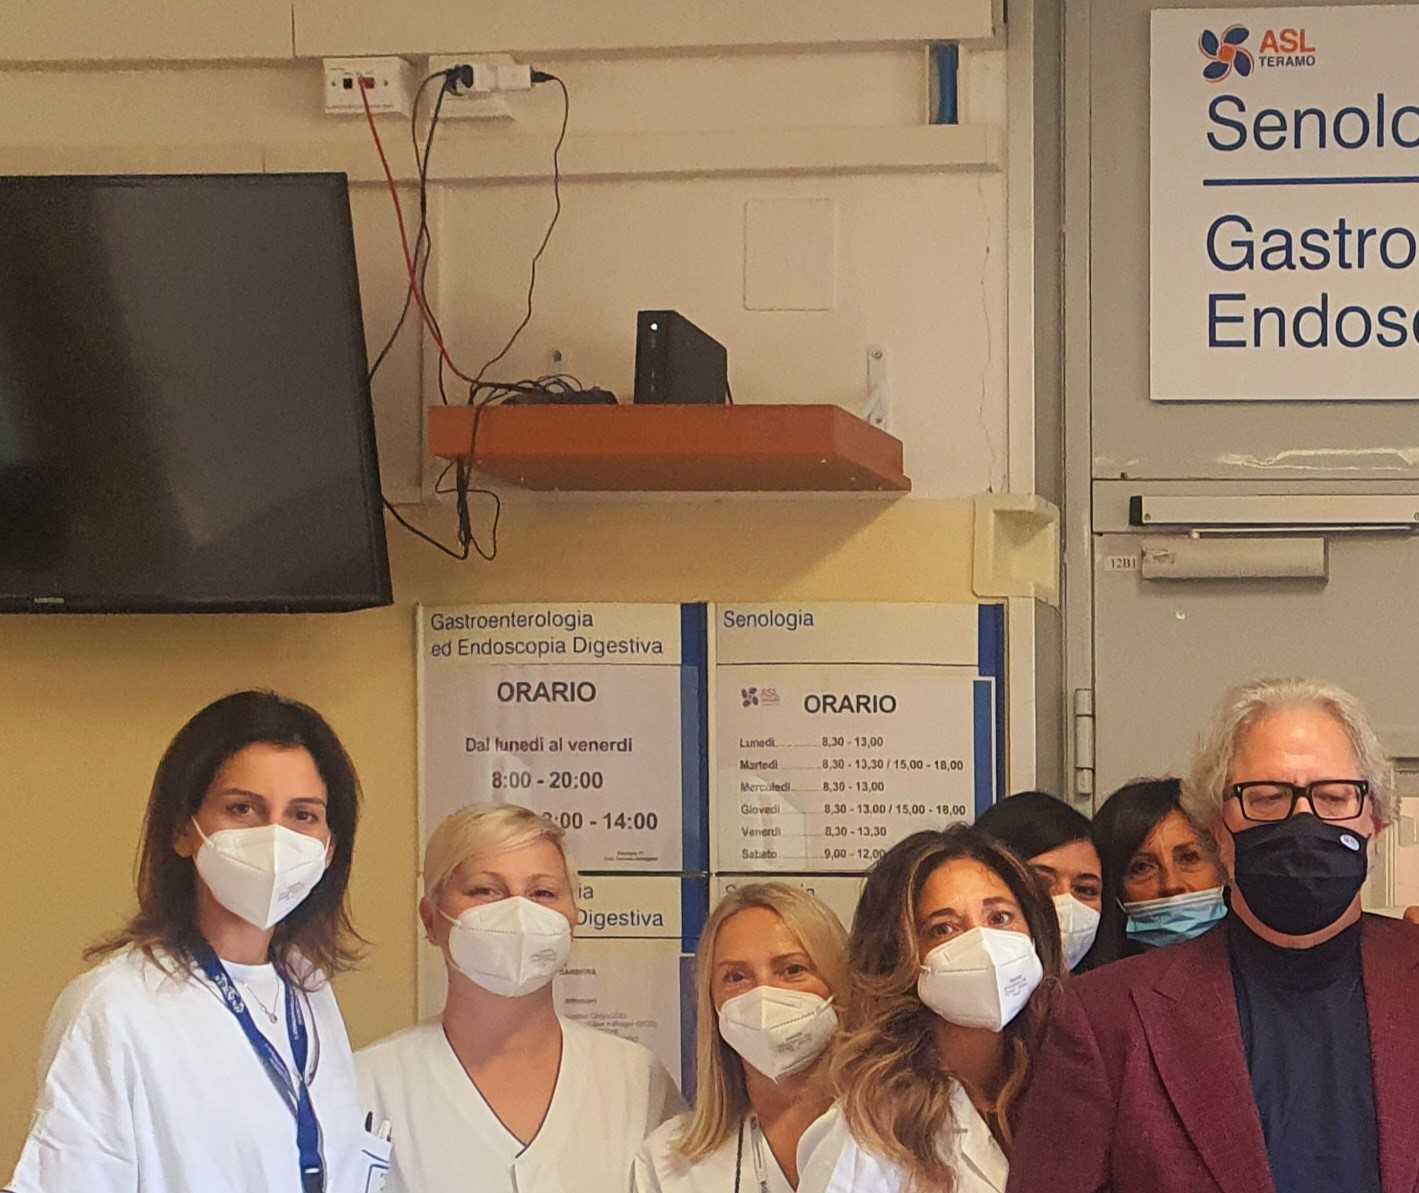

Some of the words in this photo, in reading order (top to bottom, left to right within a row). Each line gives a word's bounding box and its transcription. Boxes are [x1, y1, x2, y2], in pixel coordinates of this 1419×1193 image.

[1258, 28, 1316, 54] ASL
[1258, 55, 1316, 68] TERAMO
[431, 611, 594, 631] Gastroenterologia
[723, 610, 815, 631] Senologia
[431, 640, 452, 657] ed
[458, 637, 566, 658] Endoscopia
[572, 636, 664, 657] Digestiva
[497, 681, 597, 703] ORARIO
[803, 694, 897, 714] ORARIO
[465, 737, 490, 753] Dal
[549, 737, 563, 752] al
[491, 771, 532, 790] 8:00
[549, 770, 604, 789] 20:00
[603, 811, 658, 830] 14:00
[577, 908, 664, 930] Digestiva
